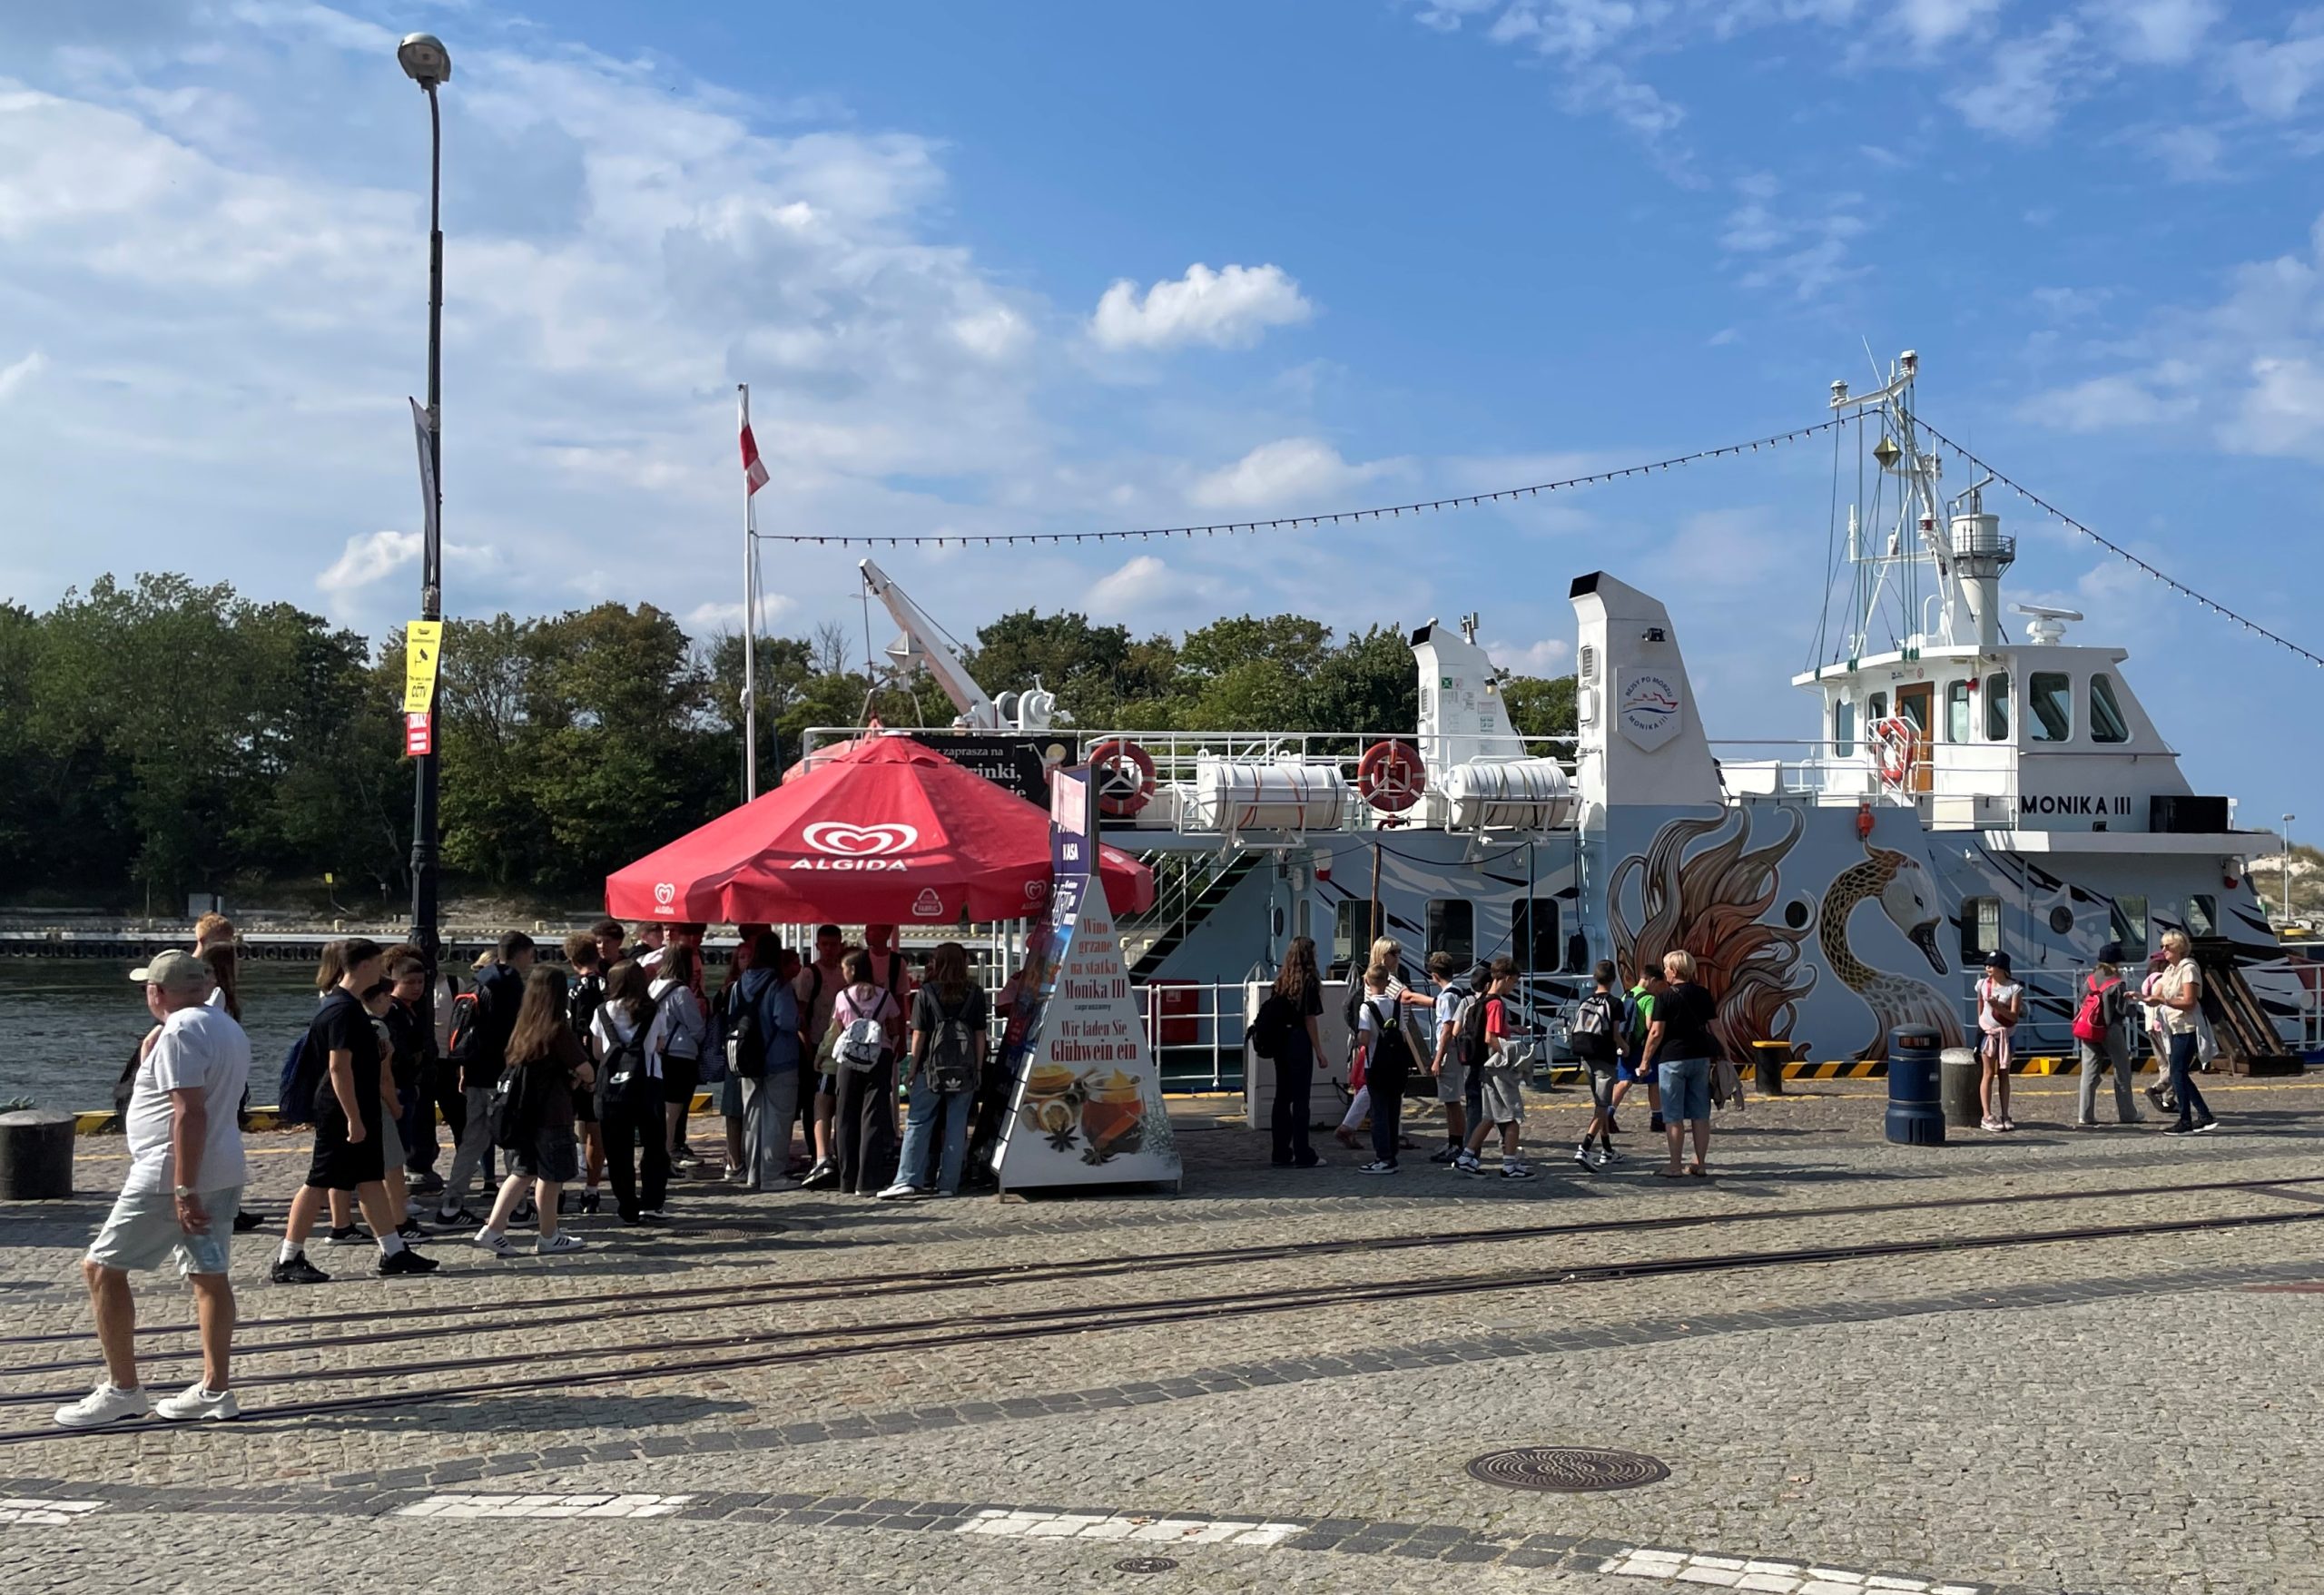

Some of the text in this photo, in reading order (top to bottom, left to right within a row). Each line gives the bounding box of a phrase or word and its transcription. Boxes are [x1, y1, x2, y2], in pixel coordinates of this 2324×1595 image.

[1629, 715, 1659, 730] MONIKA
[943, 747, 989, 759] zaprasza
[990, 747, 1004, 757] na
[969, 763, 1022, 782] rinki,
[2021, 795, 2131, 815] MONIKA III
[789, 857, 908, 871] ALGIDA
[1083, 918, 1108, 935] Wino
[1078, 940, 1112, 956] grzane
[1070, 960, 1118, 975] na statku
[1065, 979, 1126, 999] Monika III
[1075, 1004, 1111, 1012] zapraszamy
[1061, 1019, 1128, 1037] Wir laden Sie
[1050, 1038, 1137, 1061] Glühwein ein
